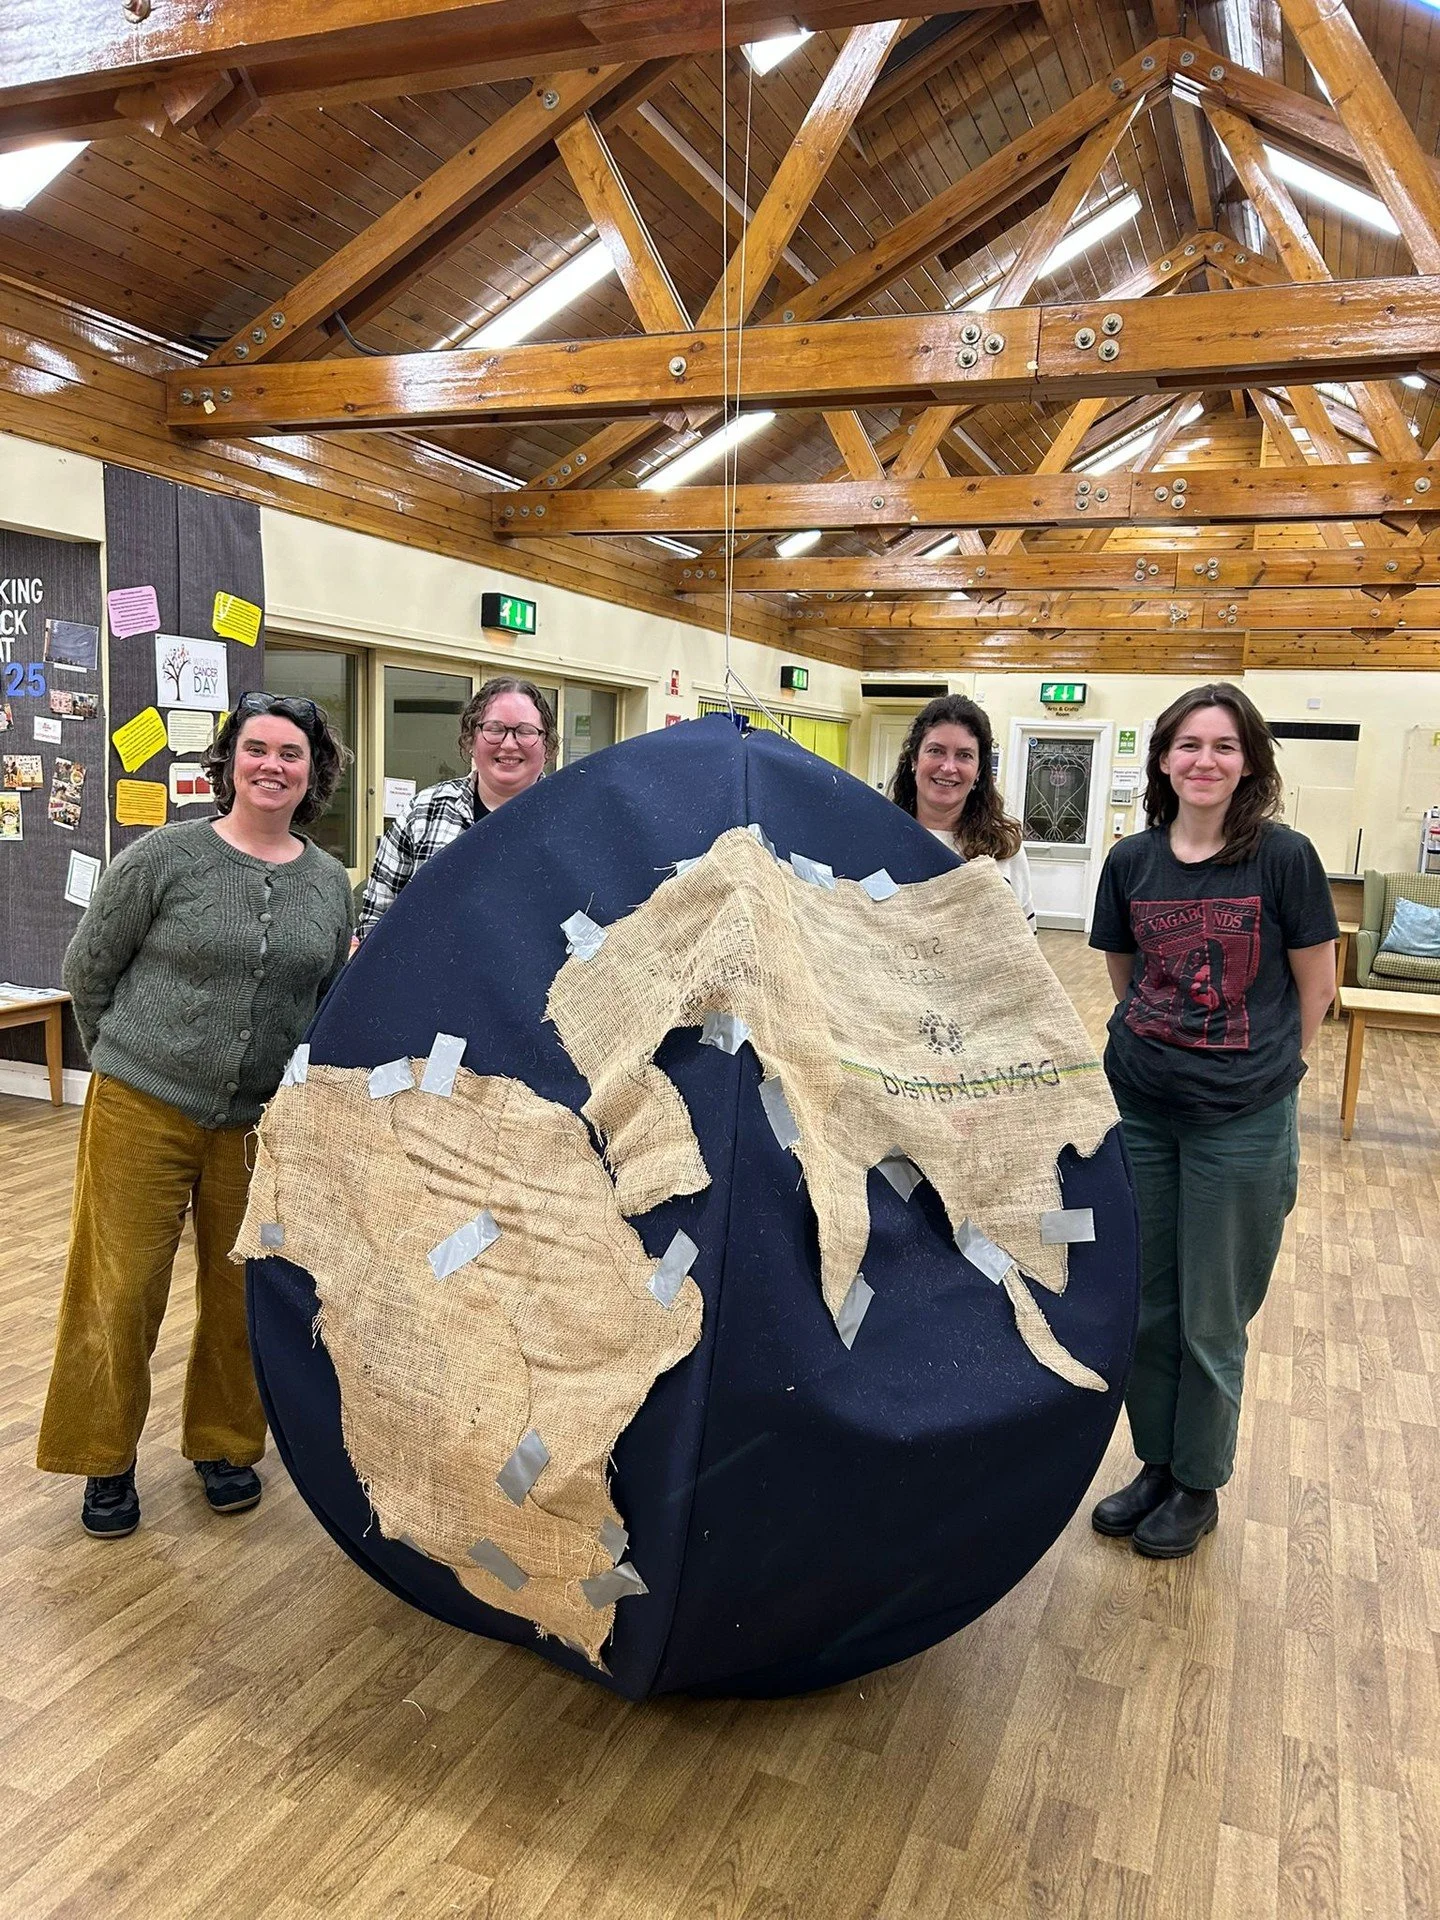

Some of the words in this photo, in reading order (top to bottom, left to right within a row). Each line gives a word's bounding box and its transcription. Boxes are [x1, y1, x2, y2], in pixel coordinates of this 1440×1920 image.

[0, 609, 28, 635] CK
[193, 665, 219, 678] CANCER
[194, 676, 219, 695] DAY
